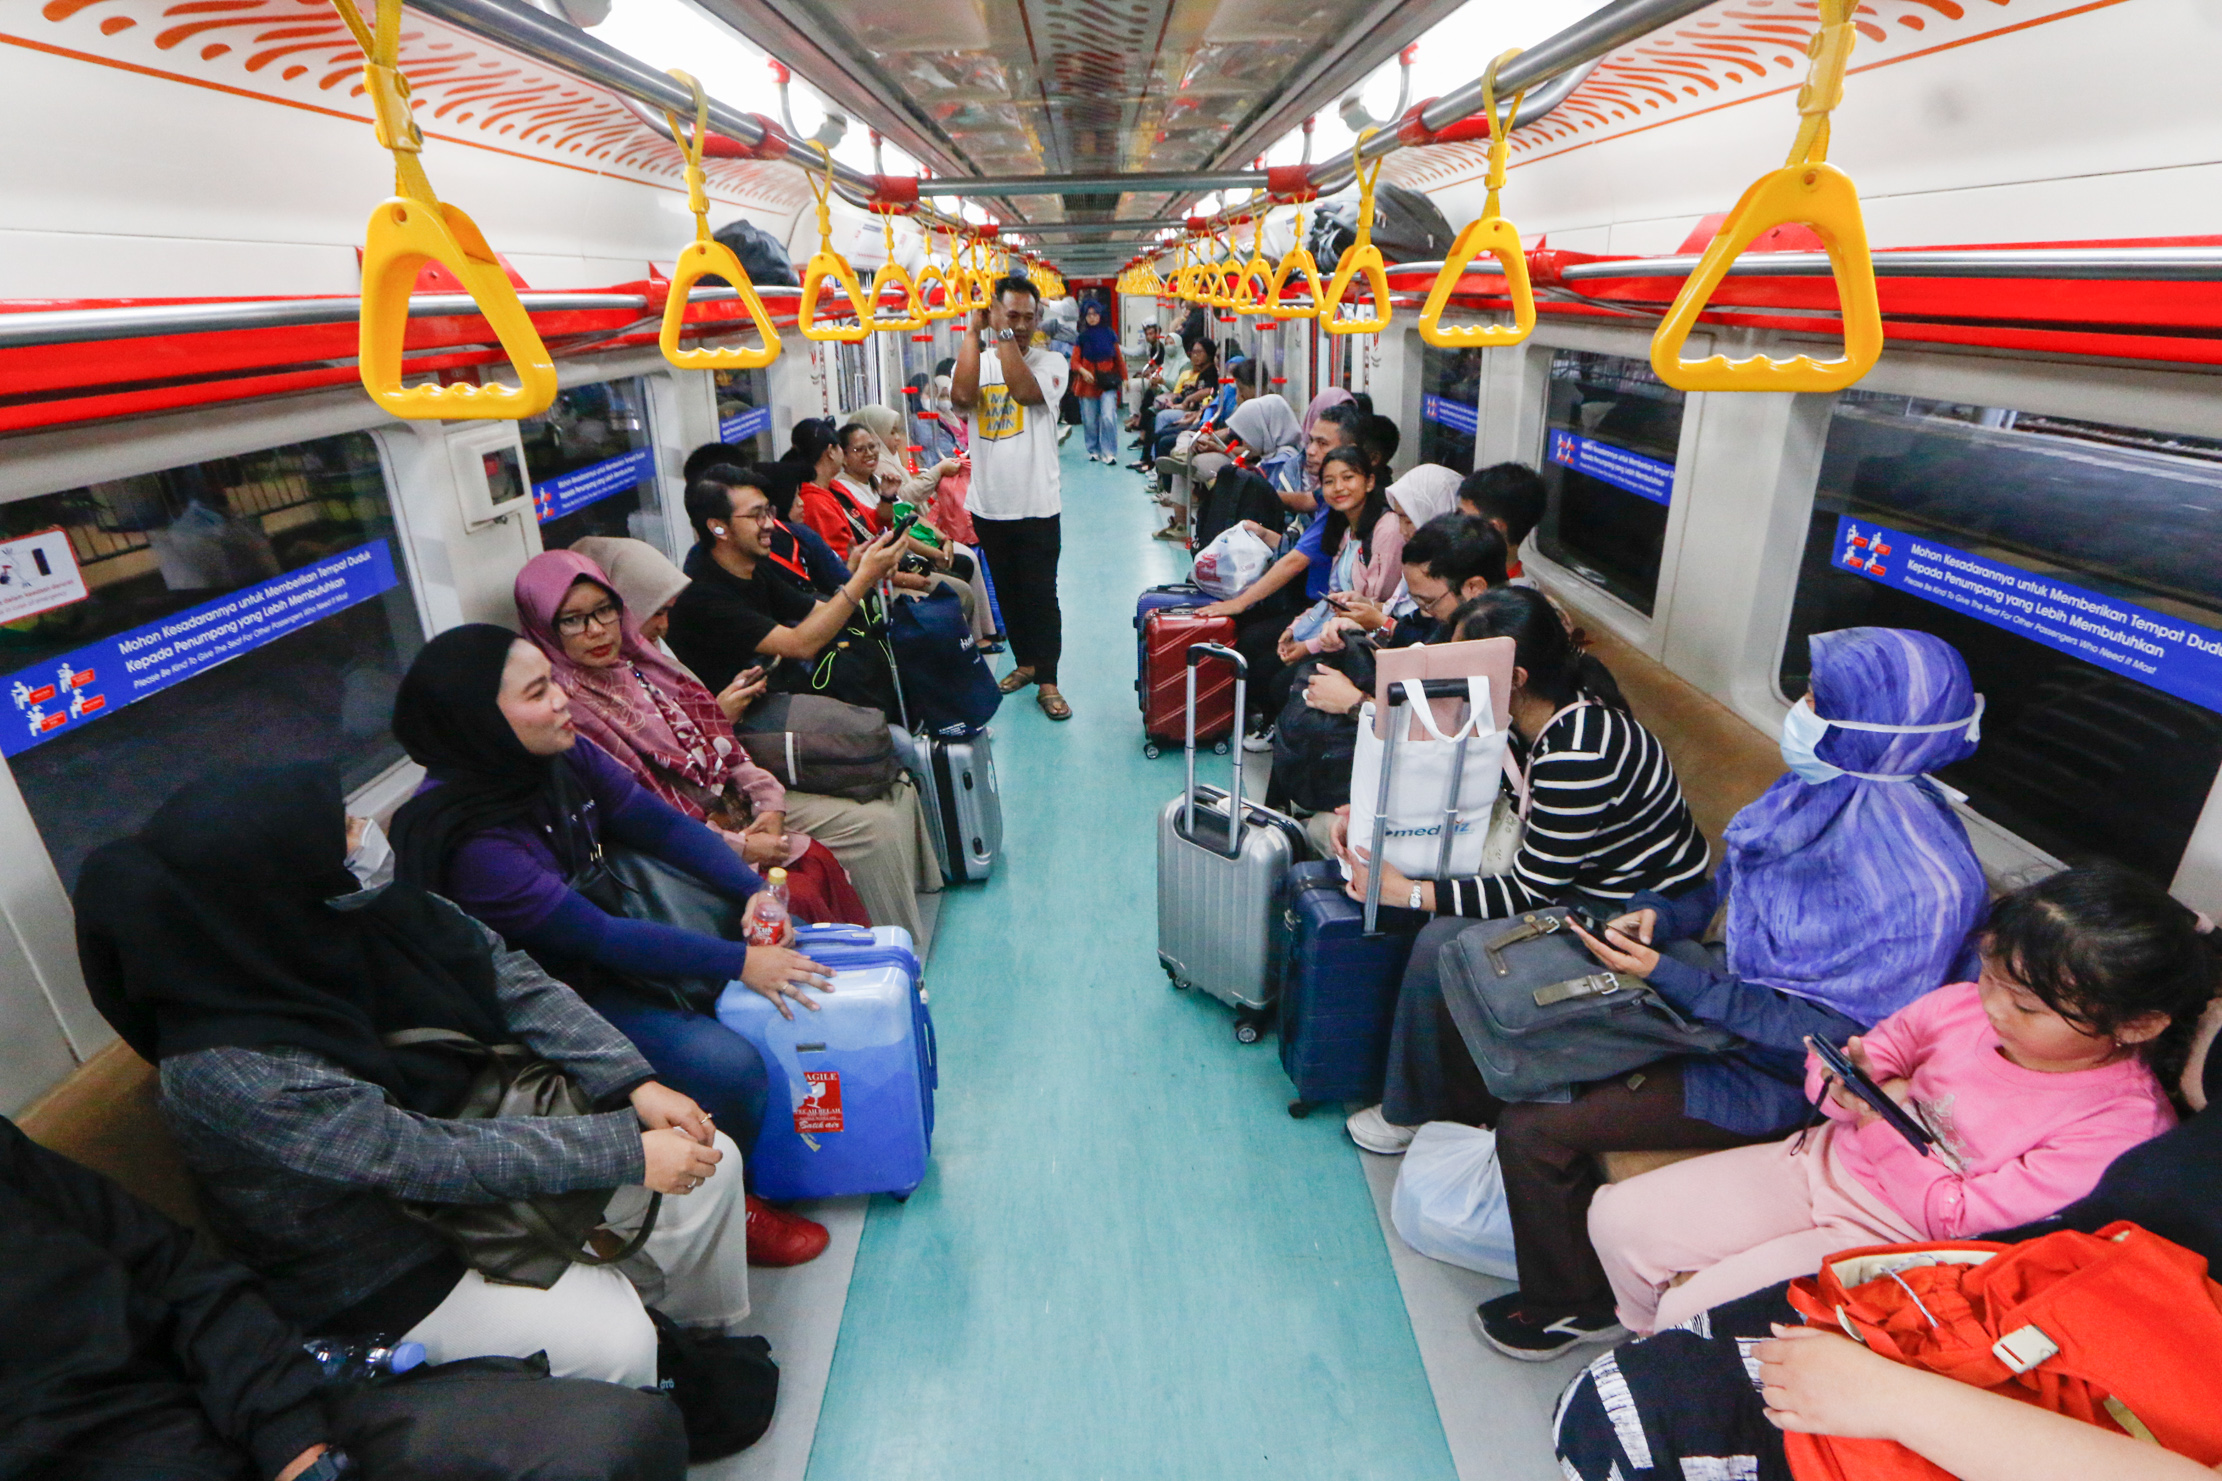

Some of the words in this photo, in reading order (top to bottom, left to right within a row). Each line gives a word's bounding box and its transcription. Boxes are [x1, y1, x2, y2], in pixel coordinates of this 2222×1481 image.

[118, 632, 162, 655] Mohon
[161, 603, 238, 638] Kesadarannya
[238, 592, 265, 609] untuk
[264, 572, 318, 598] Memberikan
[317, 559, 348, 578] Tempat
[347, 550, 372, 567] Duduk
[125, 646, 174, 673] Kepada
[173, 621, 239, 653] Penumpang
[237, 611, 263, 629] yang
[262, 600, 288, 617] Lebih
[287, 577, 346, 606] Membutuhkan
[1907, 559, 1943, 579] Kepada
[1944, 572, 2005, 603] Penumpang
[2005, 593, 2034, 614] yang
[2035, 602, 2067, 624] Lebih
[2069, 614, 2165, 658] Membutuhkan
[1911, 543, 1943, 563] Mohon
[1943, 554, 2015, 586] Kesadarannya
[2017, 579, 2048, 597] untuk
[2049, 588, 2128, 624] Memberikan
[2130, 614, 2186, 643] Tempat
[1955, 593, 1971, 605] Give
[2012, 615, 2035, 629] Other
[2033, 622, 2079, 646] Passengers
[2078, 638, 2099, 653] Who
[2099, 647, 2126, 663] Need
